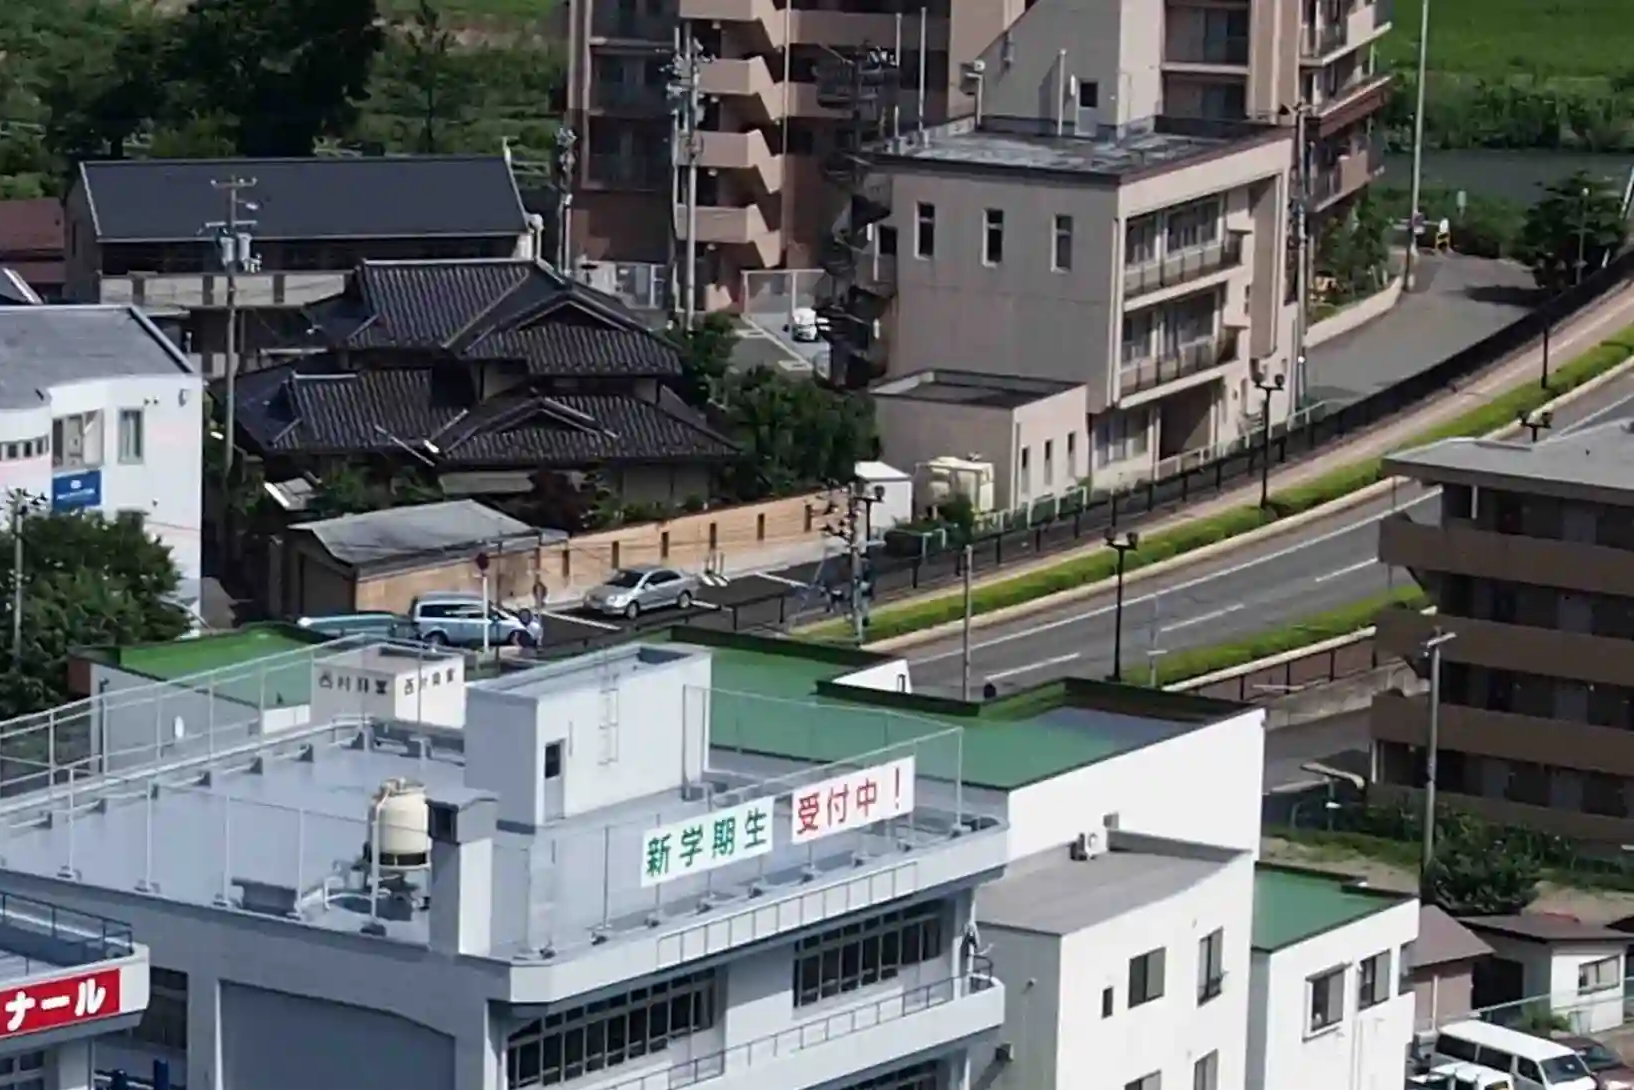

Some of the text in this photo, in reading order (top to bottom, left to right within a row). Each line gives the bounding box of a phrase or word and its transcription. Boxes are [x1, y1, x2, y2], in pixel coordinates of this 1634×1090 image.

[646, 767, 902, 877] 新学期生 受付中！
